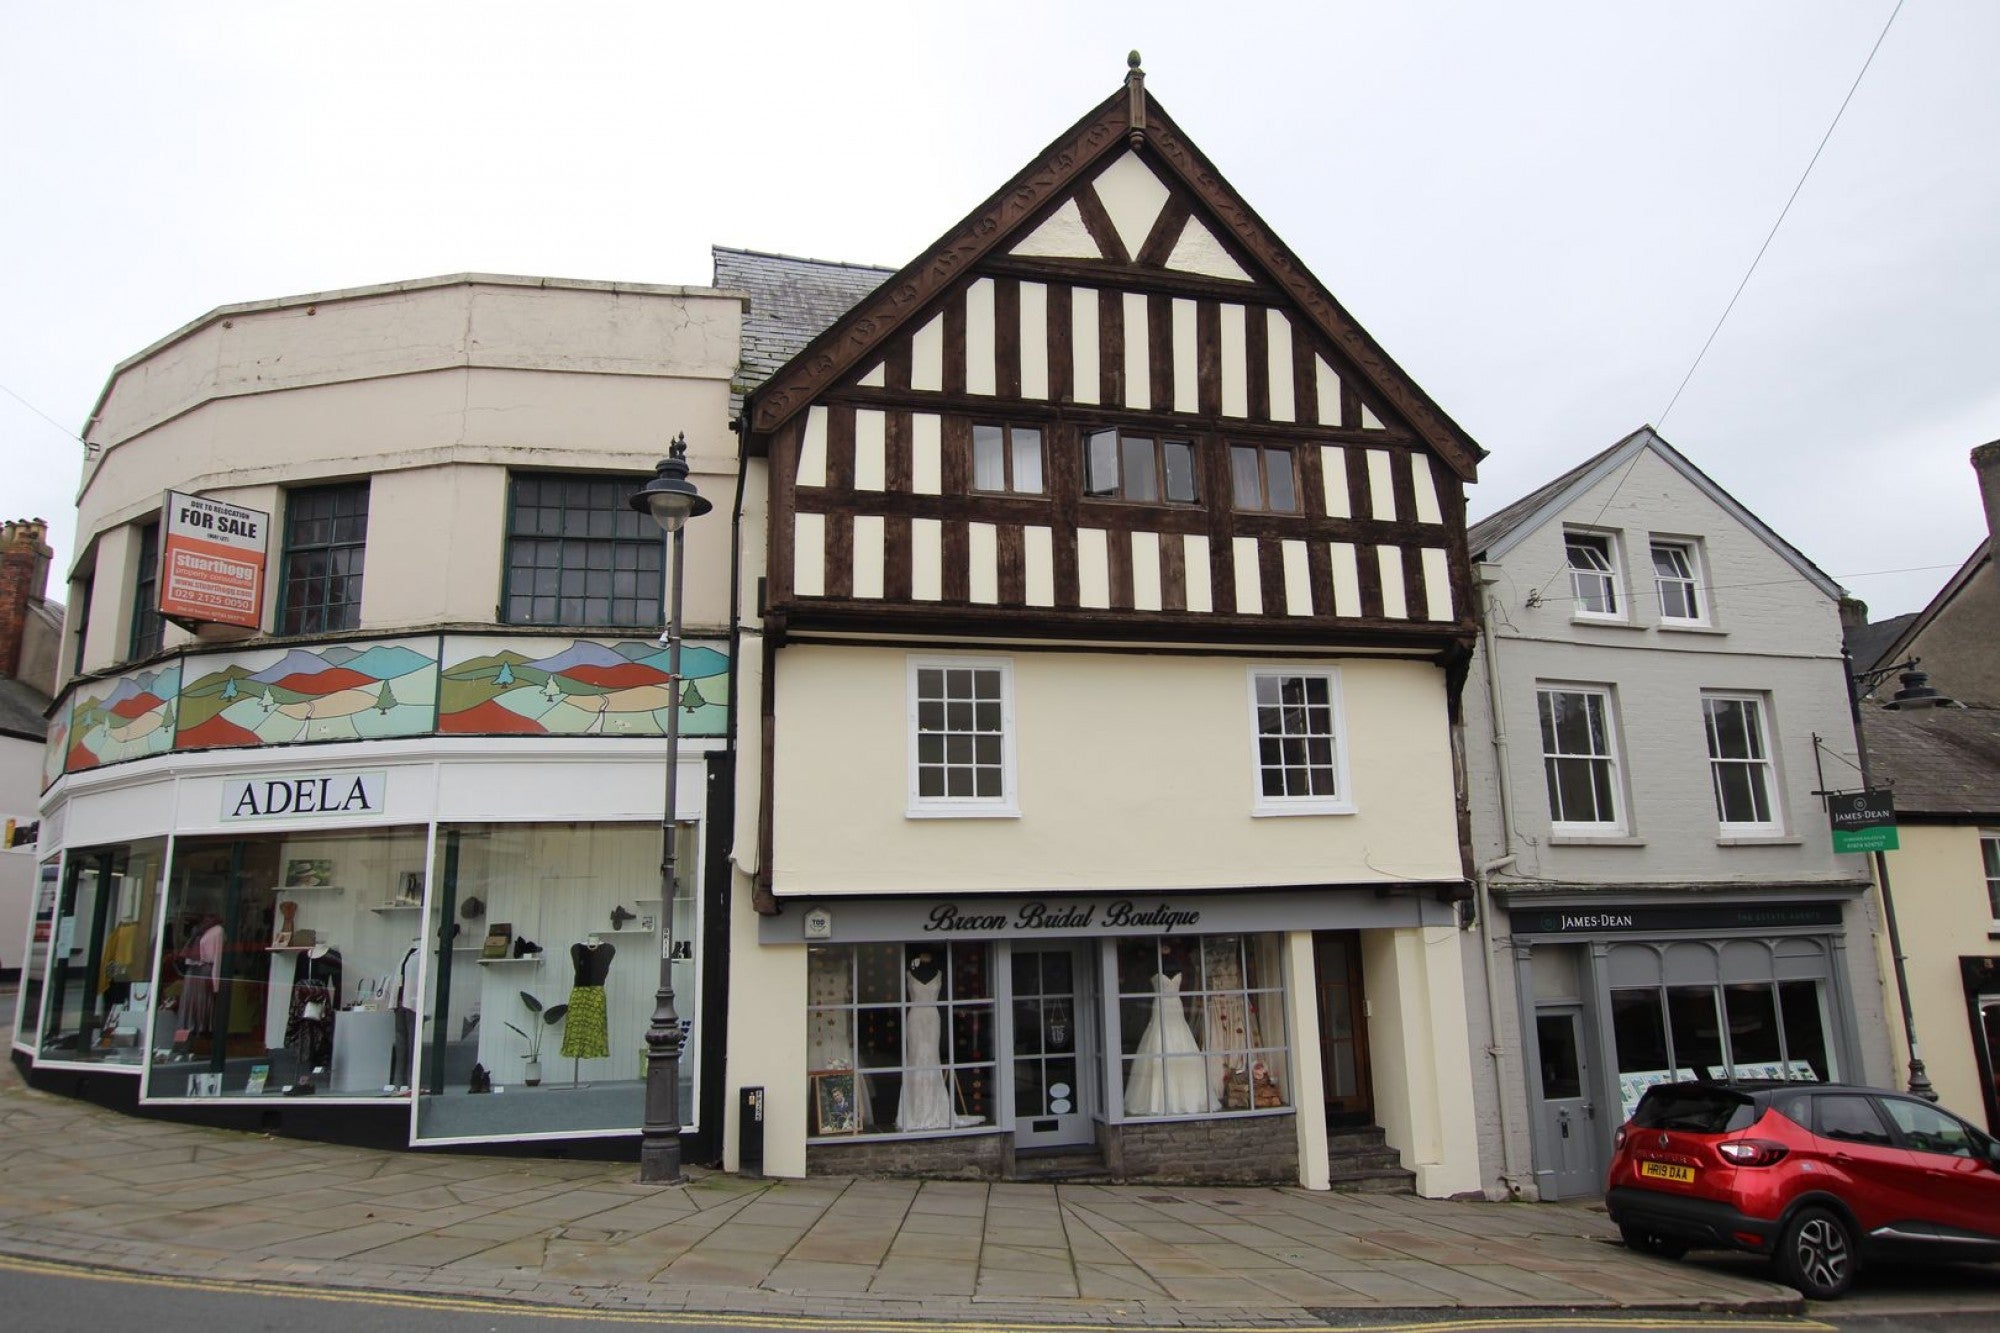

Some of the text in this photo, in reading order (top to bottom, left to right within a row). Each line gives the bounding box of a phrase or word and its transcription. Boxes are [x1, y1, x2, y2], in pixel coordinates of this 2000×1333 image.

[180, 508, 257, 539] FOR SALE
[205, 503, 213, 511] TO
[213, 505, 250, 519] RELOCATION
[177, 554, 254, 580] stuarthogg
[176, 589, 195, 599] 029
[232, 776, 371, 816] ADELA
[923, 900, 1200, 933] Brecon Bridal Boutique
[1647, 1163, 1688, 1180] HR19 DAA
